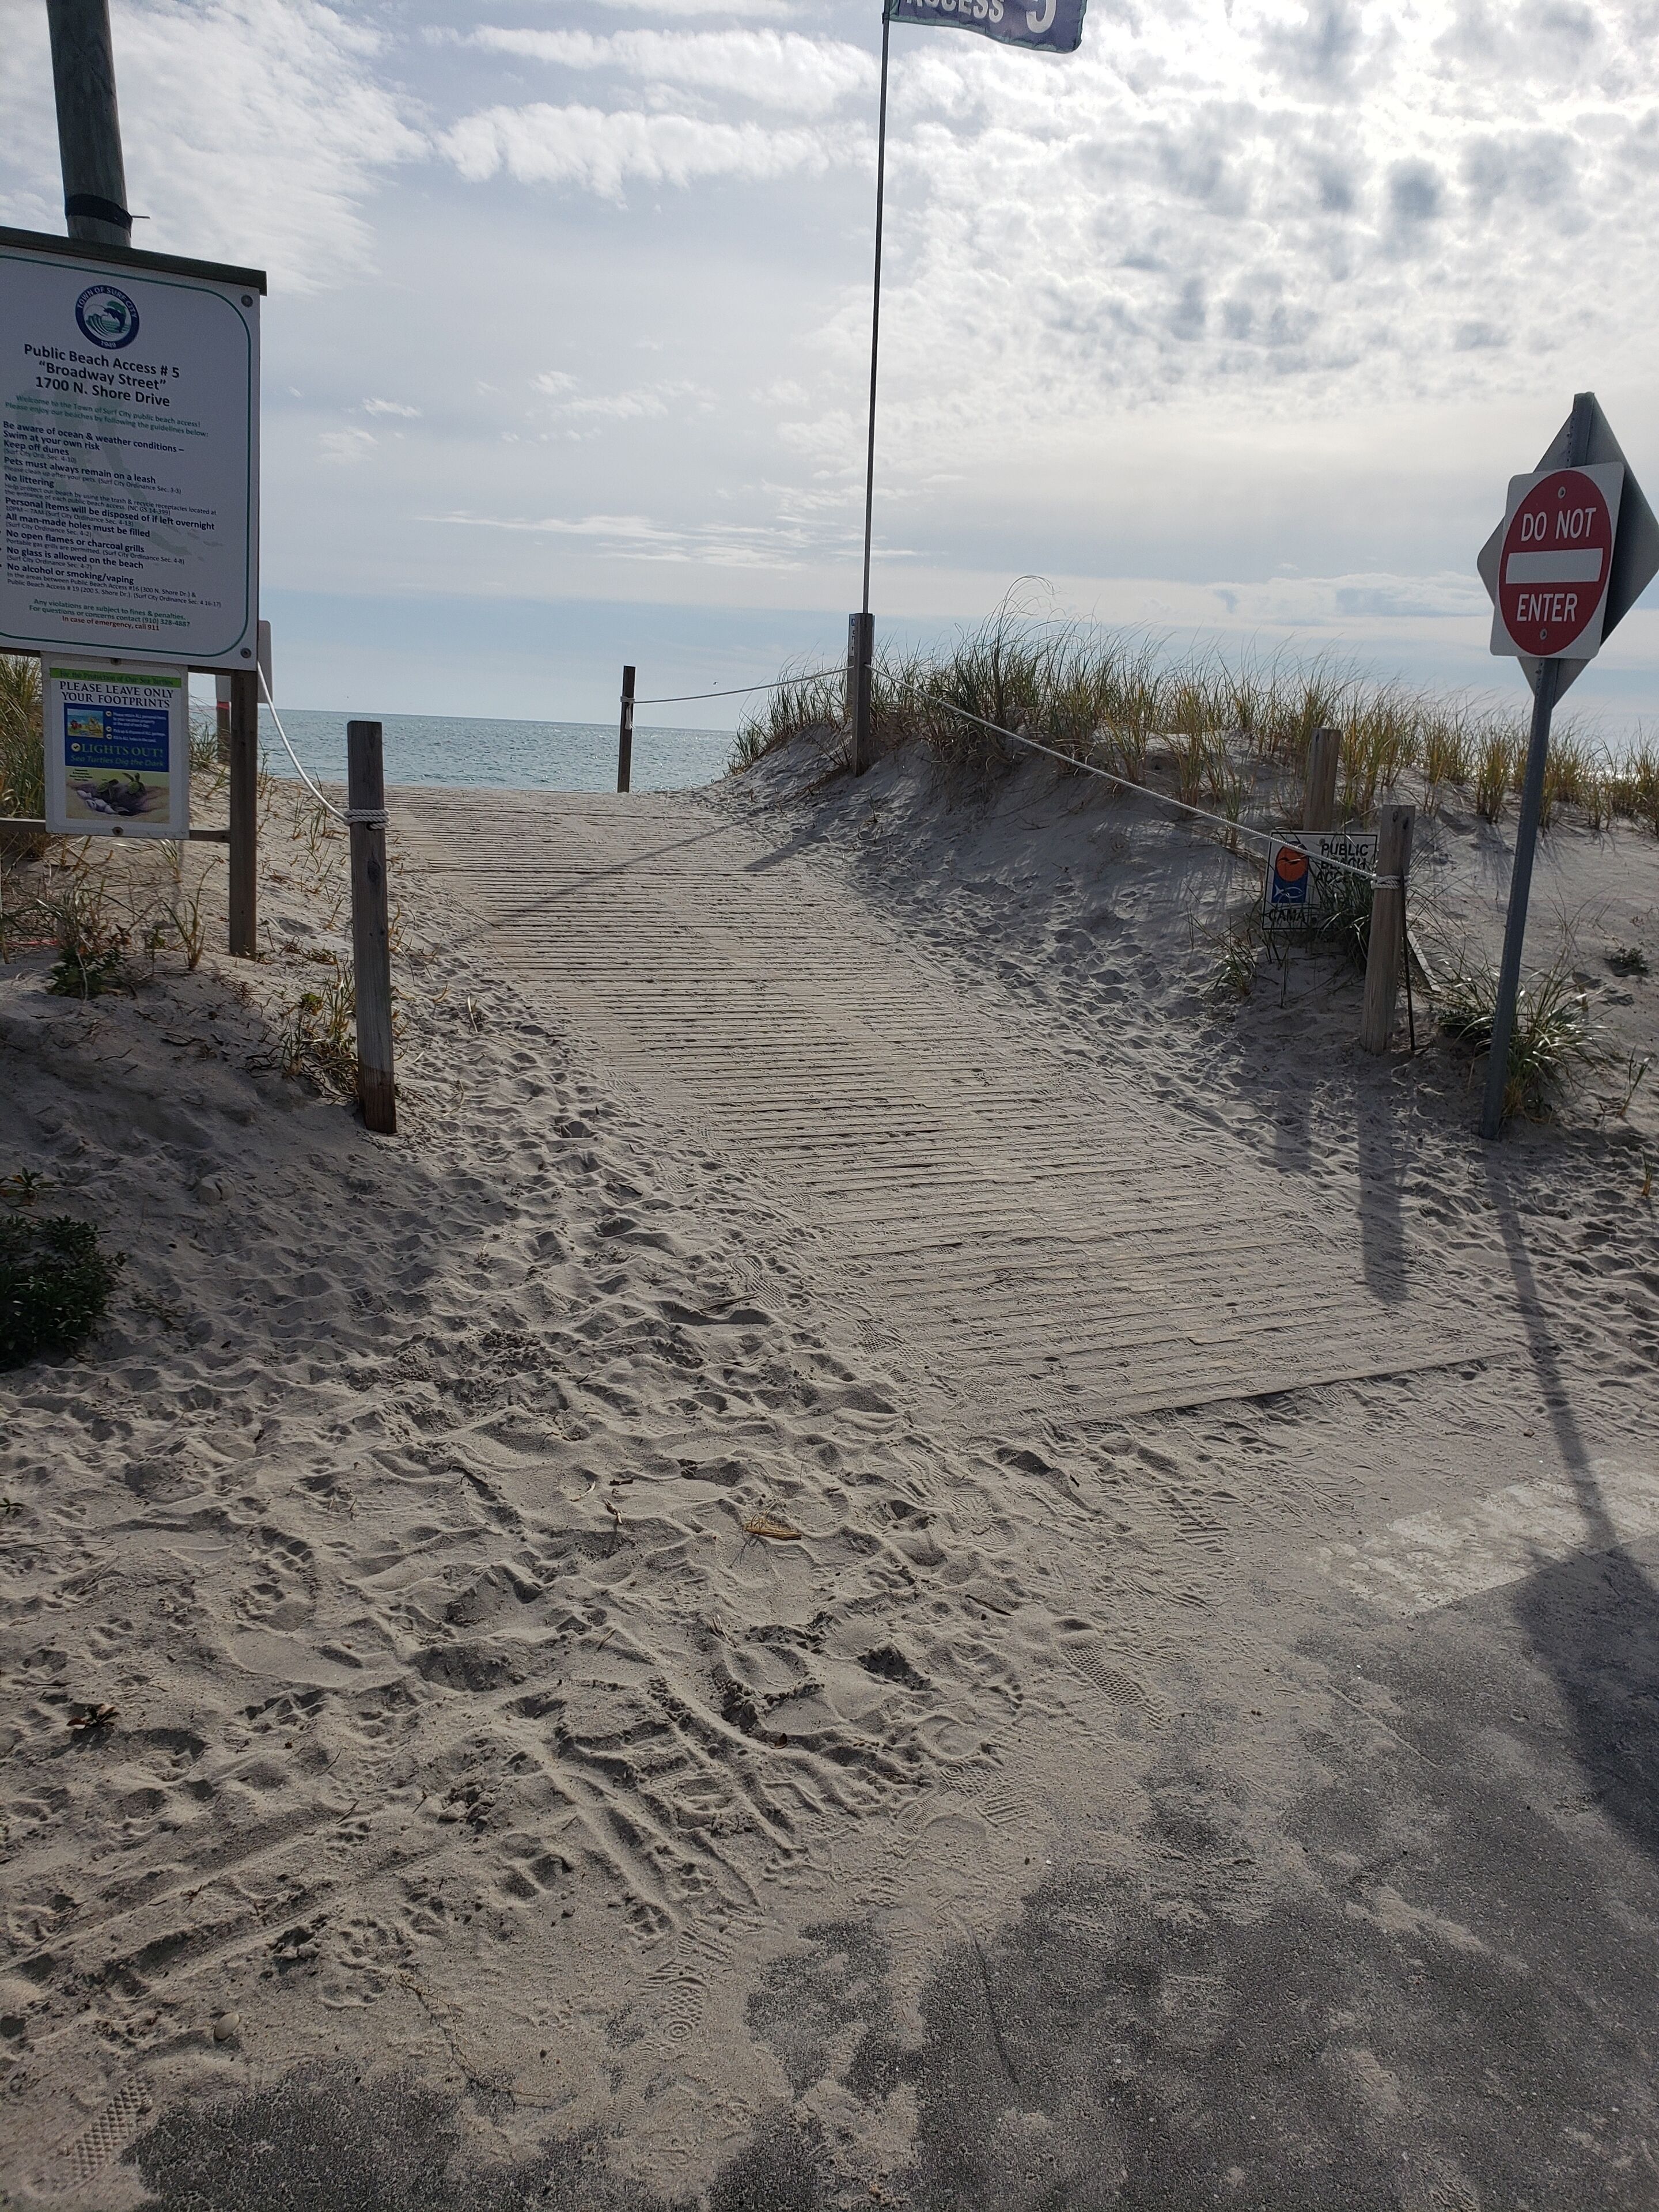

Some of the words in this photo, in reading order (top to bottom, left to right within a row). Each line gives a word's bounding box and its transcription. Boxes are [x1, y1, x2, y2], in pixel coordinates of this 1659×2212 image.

[77, 289, 93, 309] TOWN
[24, 343, 65, 361] Public
[69, 350, 109, 367] Beach
[113, 358, 156, 374] Access
[160, 365, 168, 376] #
[172, 367, 179, 378] 5
[36, 376, 69, 391] 1700
[73, 381, 87, 394] N.
[92, 385, 131, 400] Shore
[135, 391, 169, 406] Drive
[3, 421, 14, 429] Be
[17, 424, 44, 433] aware
[58, 430, 84, 441] ocean
[85, 433, 93, 441] &
[95, 435, 131, 445] weather
[133, 441, 177, 452] conditions
[3, 430, 27, 440] Swim
[29, 434, 39, 442] at
[41, 437, 62, 445] your
[62, 440, 82, 448] own
[84, 442, 100, 450] risk
[3, 439, 26, 452] Keep
[28, 443, 40, 452] off
[43, 445, 69, 455] dunes
[4, 456, 23, 465] Pets
[25, 461, 47, 469] must
[49, 463, 79, 474] always
[81, 468, 111, 478] remain
[134, 474, 156, 484] leash
[5, 473, 17, 482] No
[20, 475, 54, 488] littering
[5, 497, 43, 509] Personal
[45, 501, 70, 512] items
[89, 507, 99, 516] be
[101, 509, 139, 522] disposed
[160, 516, 173, 525] left
[175, 520, 214, 530] overnight
[6, 513, 17, 521] All
[19, 516, 66, 527] man-made
[69, 520, 91, 530] holes
[93, 525, 115, 533] must
[117, 526, 127, 535] be
[129, 528, 150, 537] filled
[1521, 512, 1547, 541] DO
[1556, 507, 1597, 540] NOT
[6, 529, 18, 537] No
[21, 533, 43, 541] open
[45, 534, 74, 544] flames
[87, 539, 123, 550] charcoal
[125, 544, 145, 555] grills
[7, 546, 19, 554] No
[21, 548, 42, 559] glass
[44, 550, 51, 558] is
[54, 552, 87, 562] allowed
[103, 557, 116, 566] the
[119, 559, 143, 569] beach
[7, 563, 20, 571] No
[22, 565, 53, 574] alcohol
[66, 571, 134, 584] smoking/vaping
[33, 599, 47, 607] Any
[48, 600, 82, 609] violations
[96, 605, 120, 613] subject
[41, 604, 75, 616] questions
[1517, 593, 1578, 622] ENTER
[94, 620, 133, 629] emergency,
[60, 681, 102, 692] PLEASE
[106, 685, 141, 696] LEAVE
[144, 688, 174, 699] ONLY
[61, 692, 93, 702] YOUR
[99, 695, 170, 708] FOOTPRINTS
[82, 744, 128, 755] LIGHTS
[131, 747, 163, 757] OUT!
[1321, 843, 1369, 857] PUBLIC
